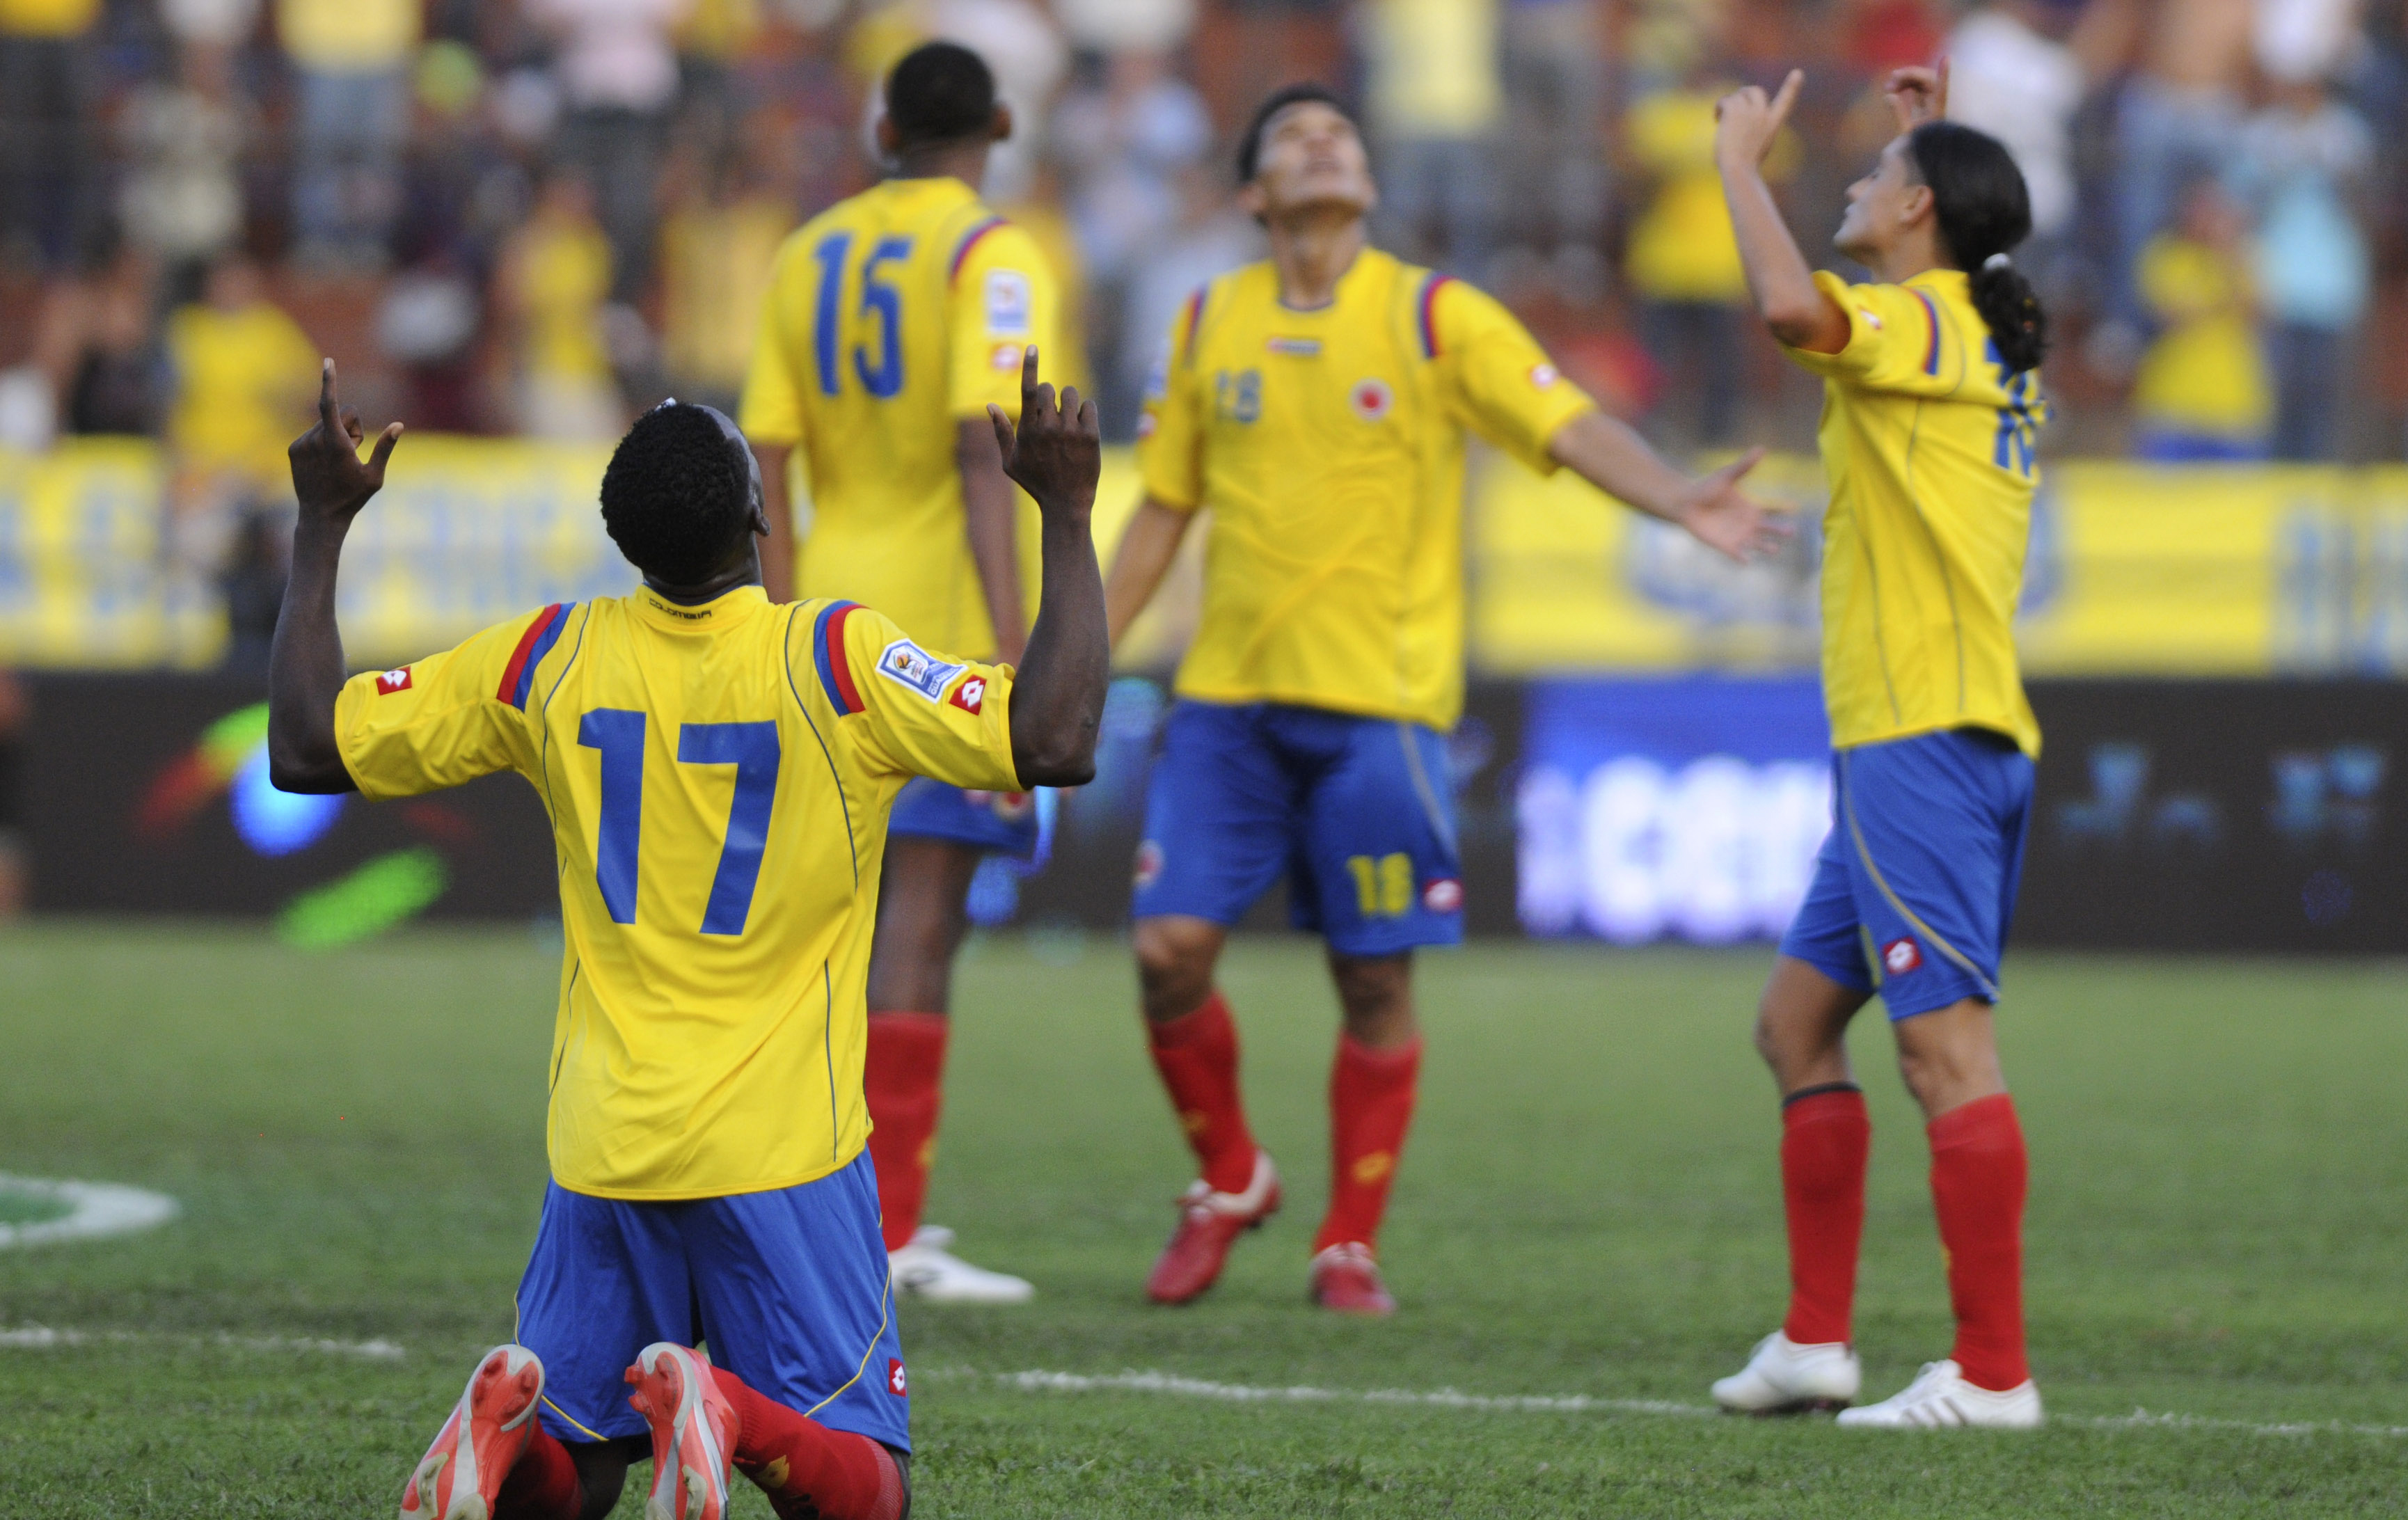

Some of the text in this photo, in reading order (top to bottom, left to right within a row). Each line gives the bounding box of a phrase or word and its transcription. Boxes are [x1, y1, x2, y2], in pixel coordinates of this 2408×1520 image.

[815, 230, 911, 397] 15
[649, 598, 712, 619] COLOMBIA
[577, 707, 781, 935] 17
